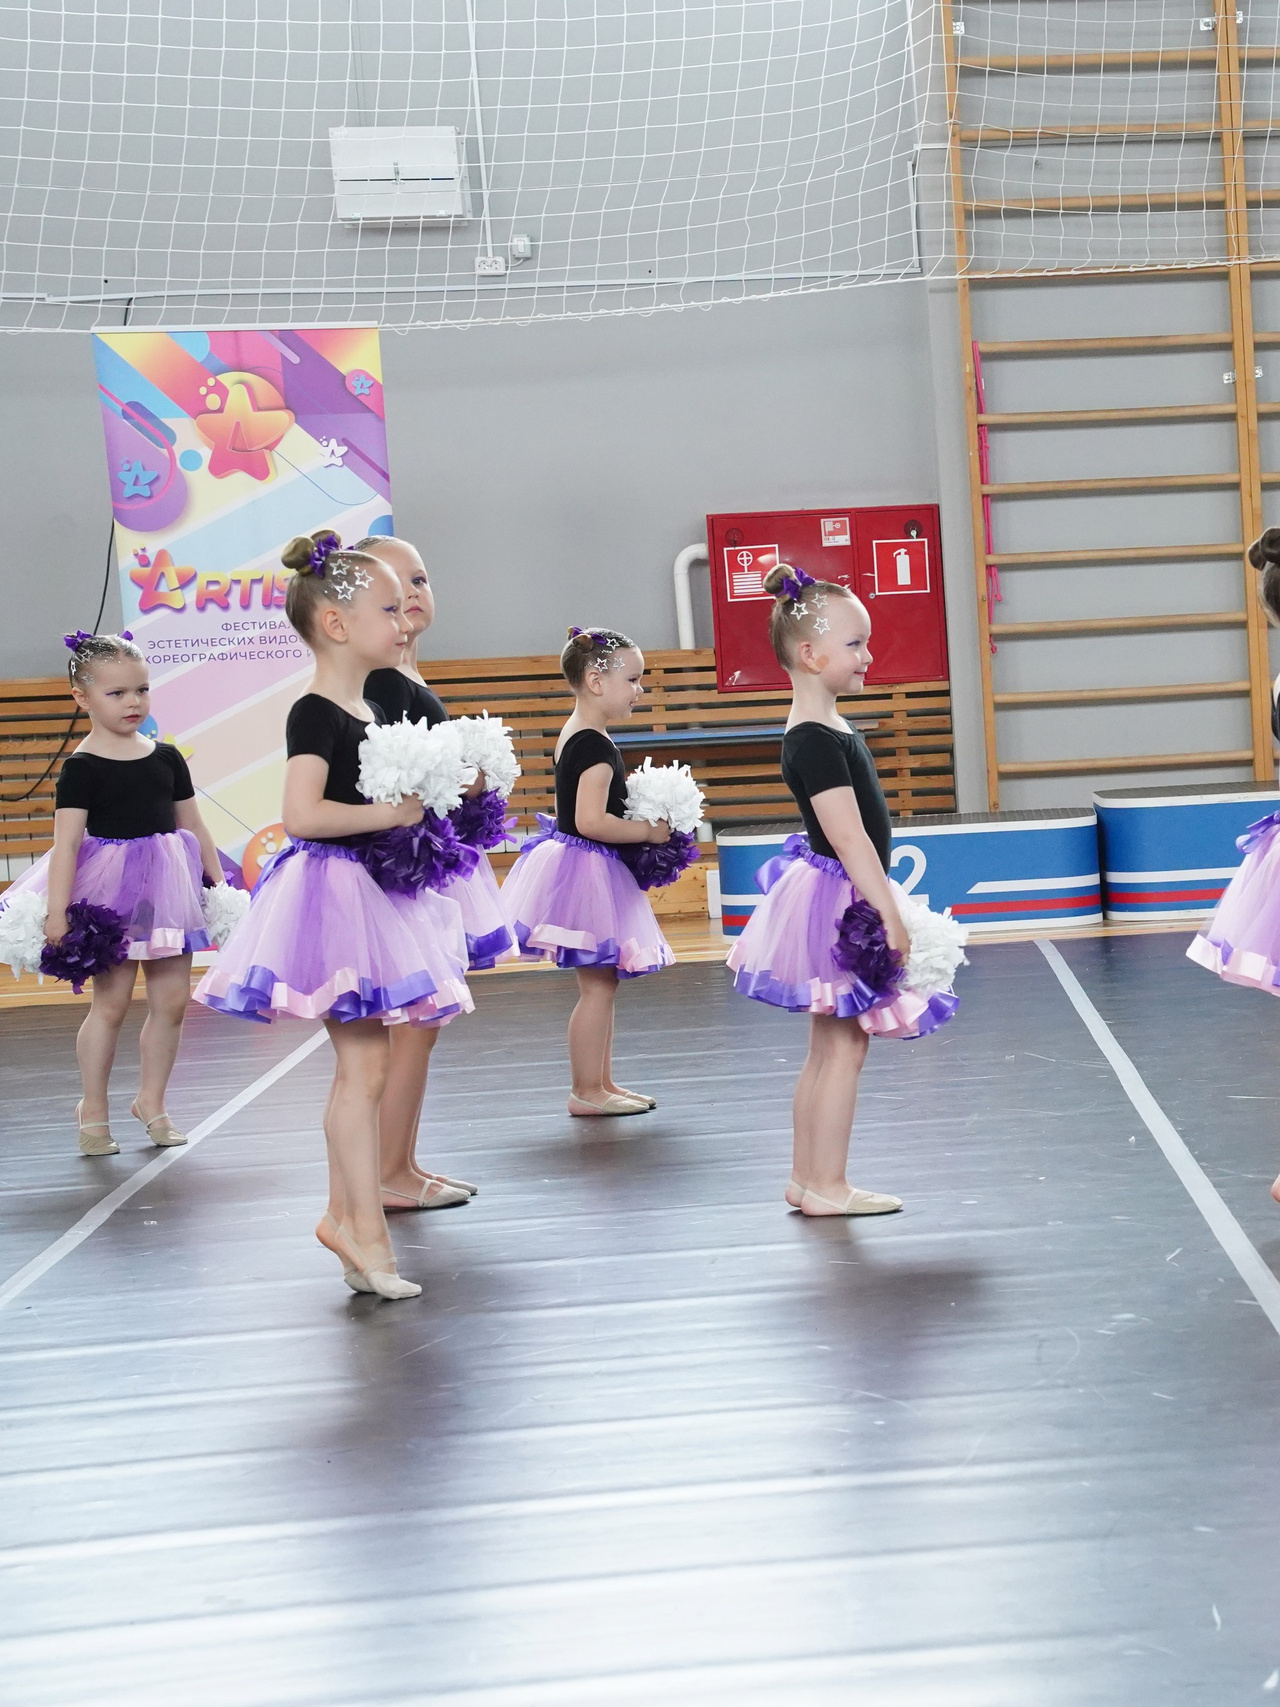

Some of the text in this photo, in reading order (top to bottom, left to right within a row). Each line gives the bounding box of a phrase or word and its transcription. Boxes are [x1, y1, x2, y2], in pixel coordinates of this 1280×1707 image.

[221, 620, 290, 632] ФЕСТИВА
[147, 634, 303, 650] ЭСТЕТИЧЕСКИХ ВИДО
[890, 844, 930, 906] 2
